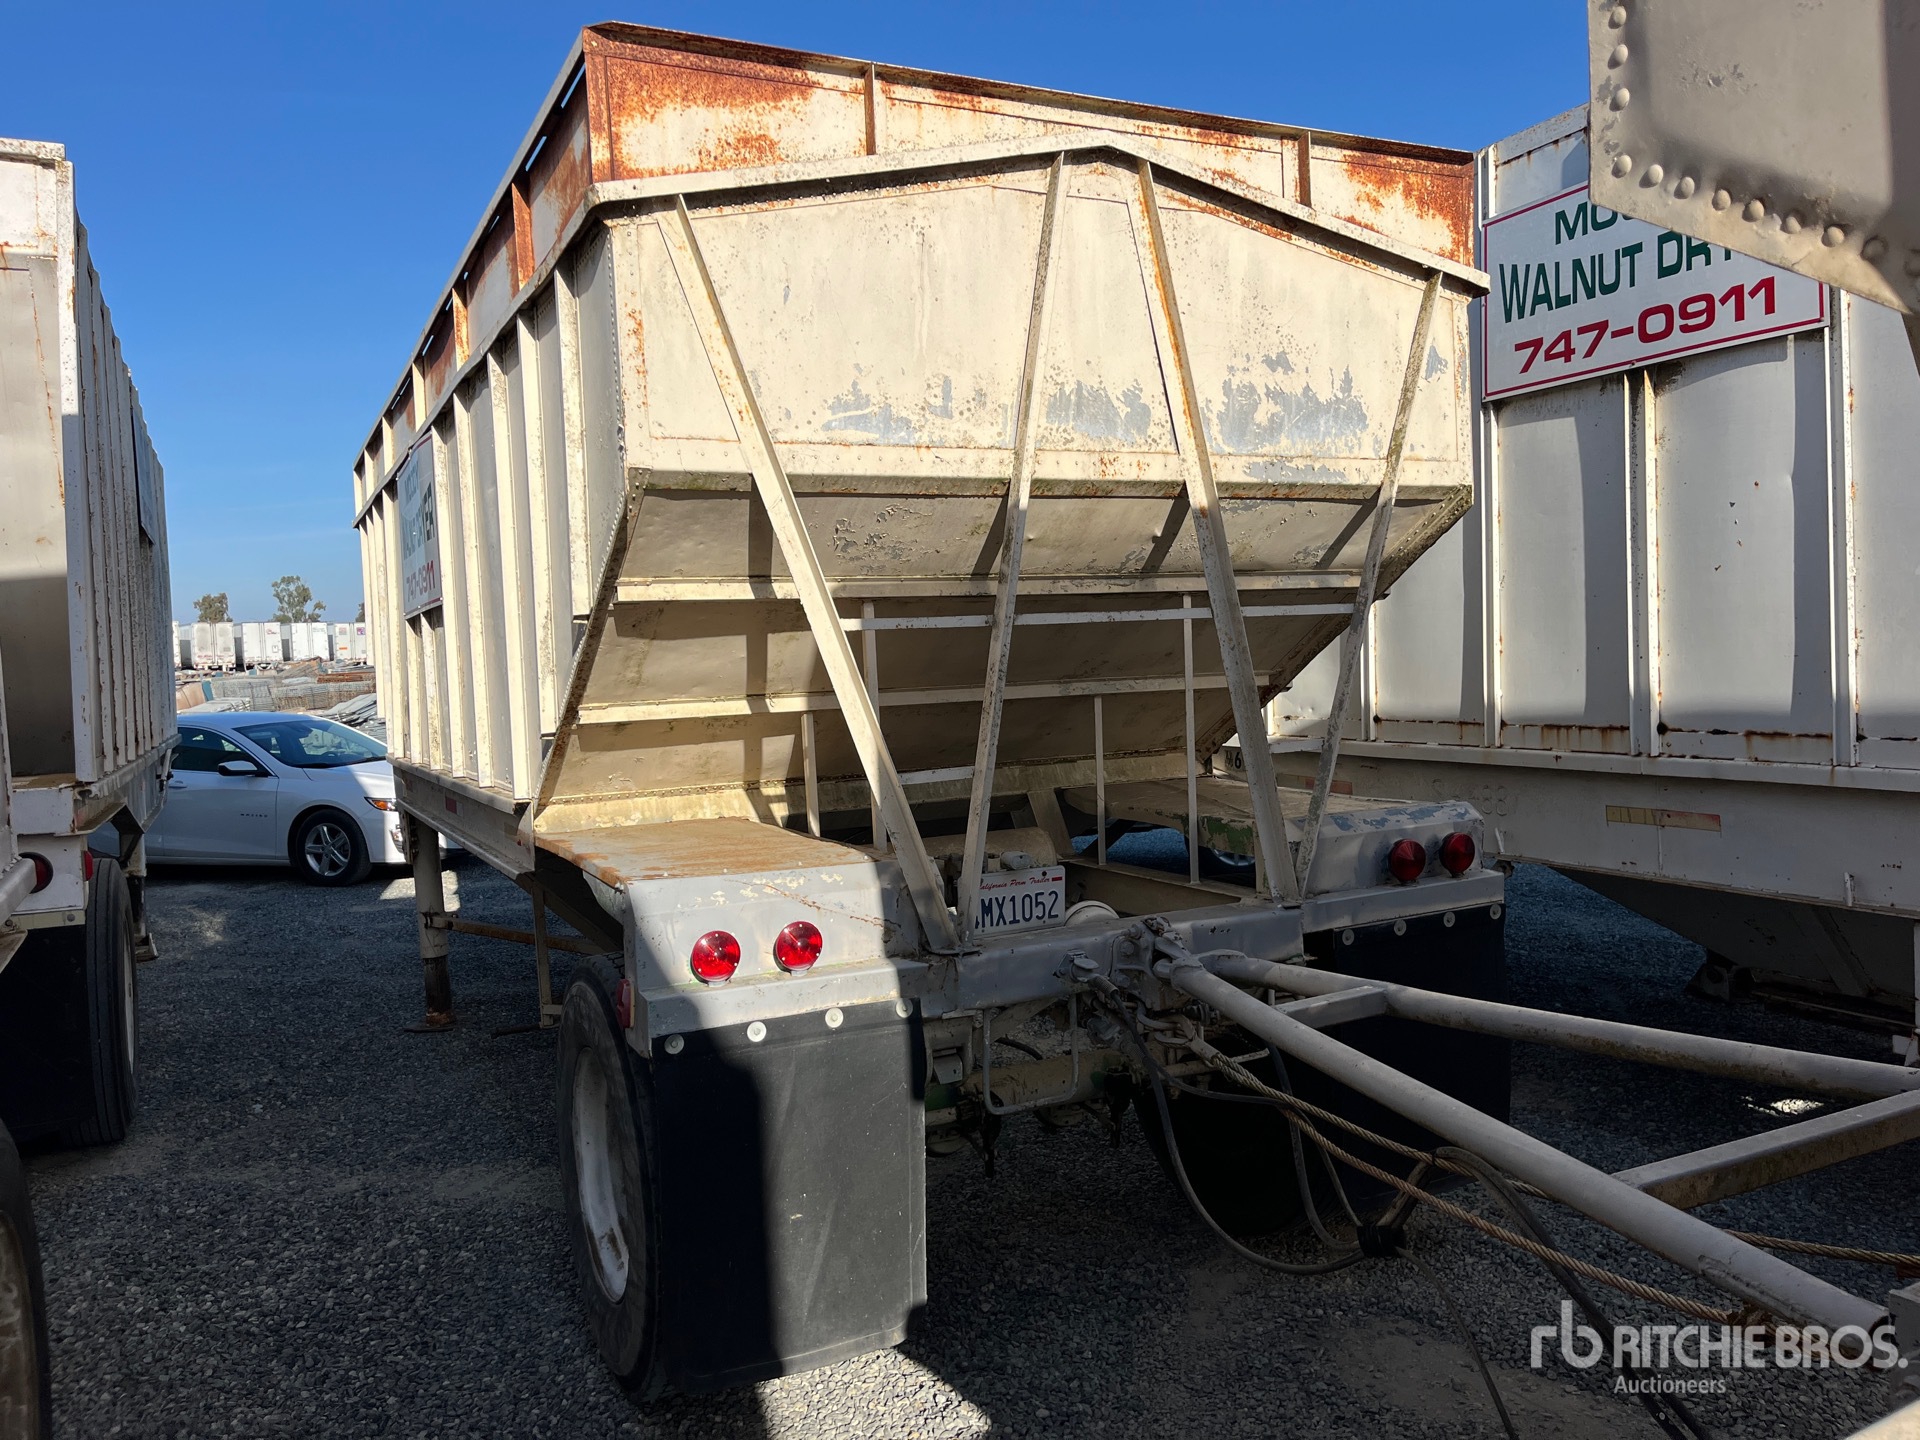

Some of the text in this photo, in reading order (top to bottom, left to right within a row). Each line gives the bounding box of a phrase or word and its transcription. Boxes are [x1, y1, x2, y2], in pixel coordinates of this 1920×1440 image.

[1499, 231, 1731, 323] WALNUT DR
[1514, 276, 1776, 375] 747-0911
[975, 890, 1059, 929] MX1052
[1010, 879, 1026, 887] Perm
[1029, 876, 1050, 884] Trailer
